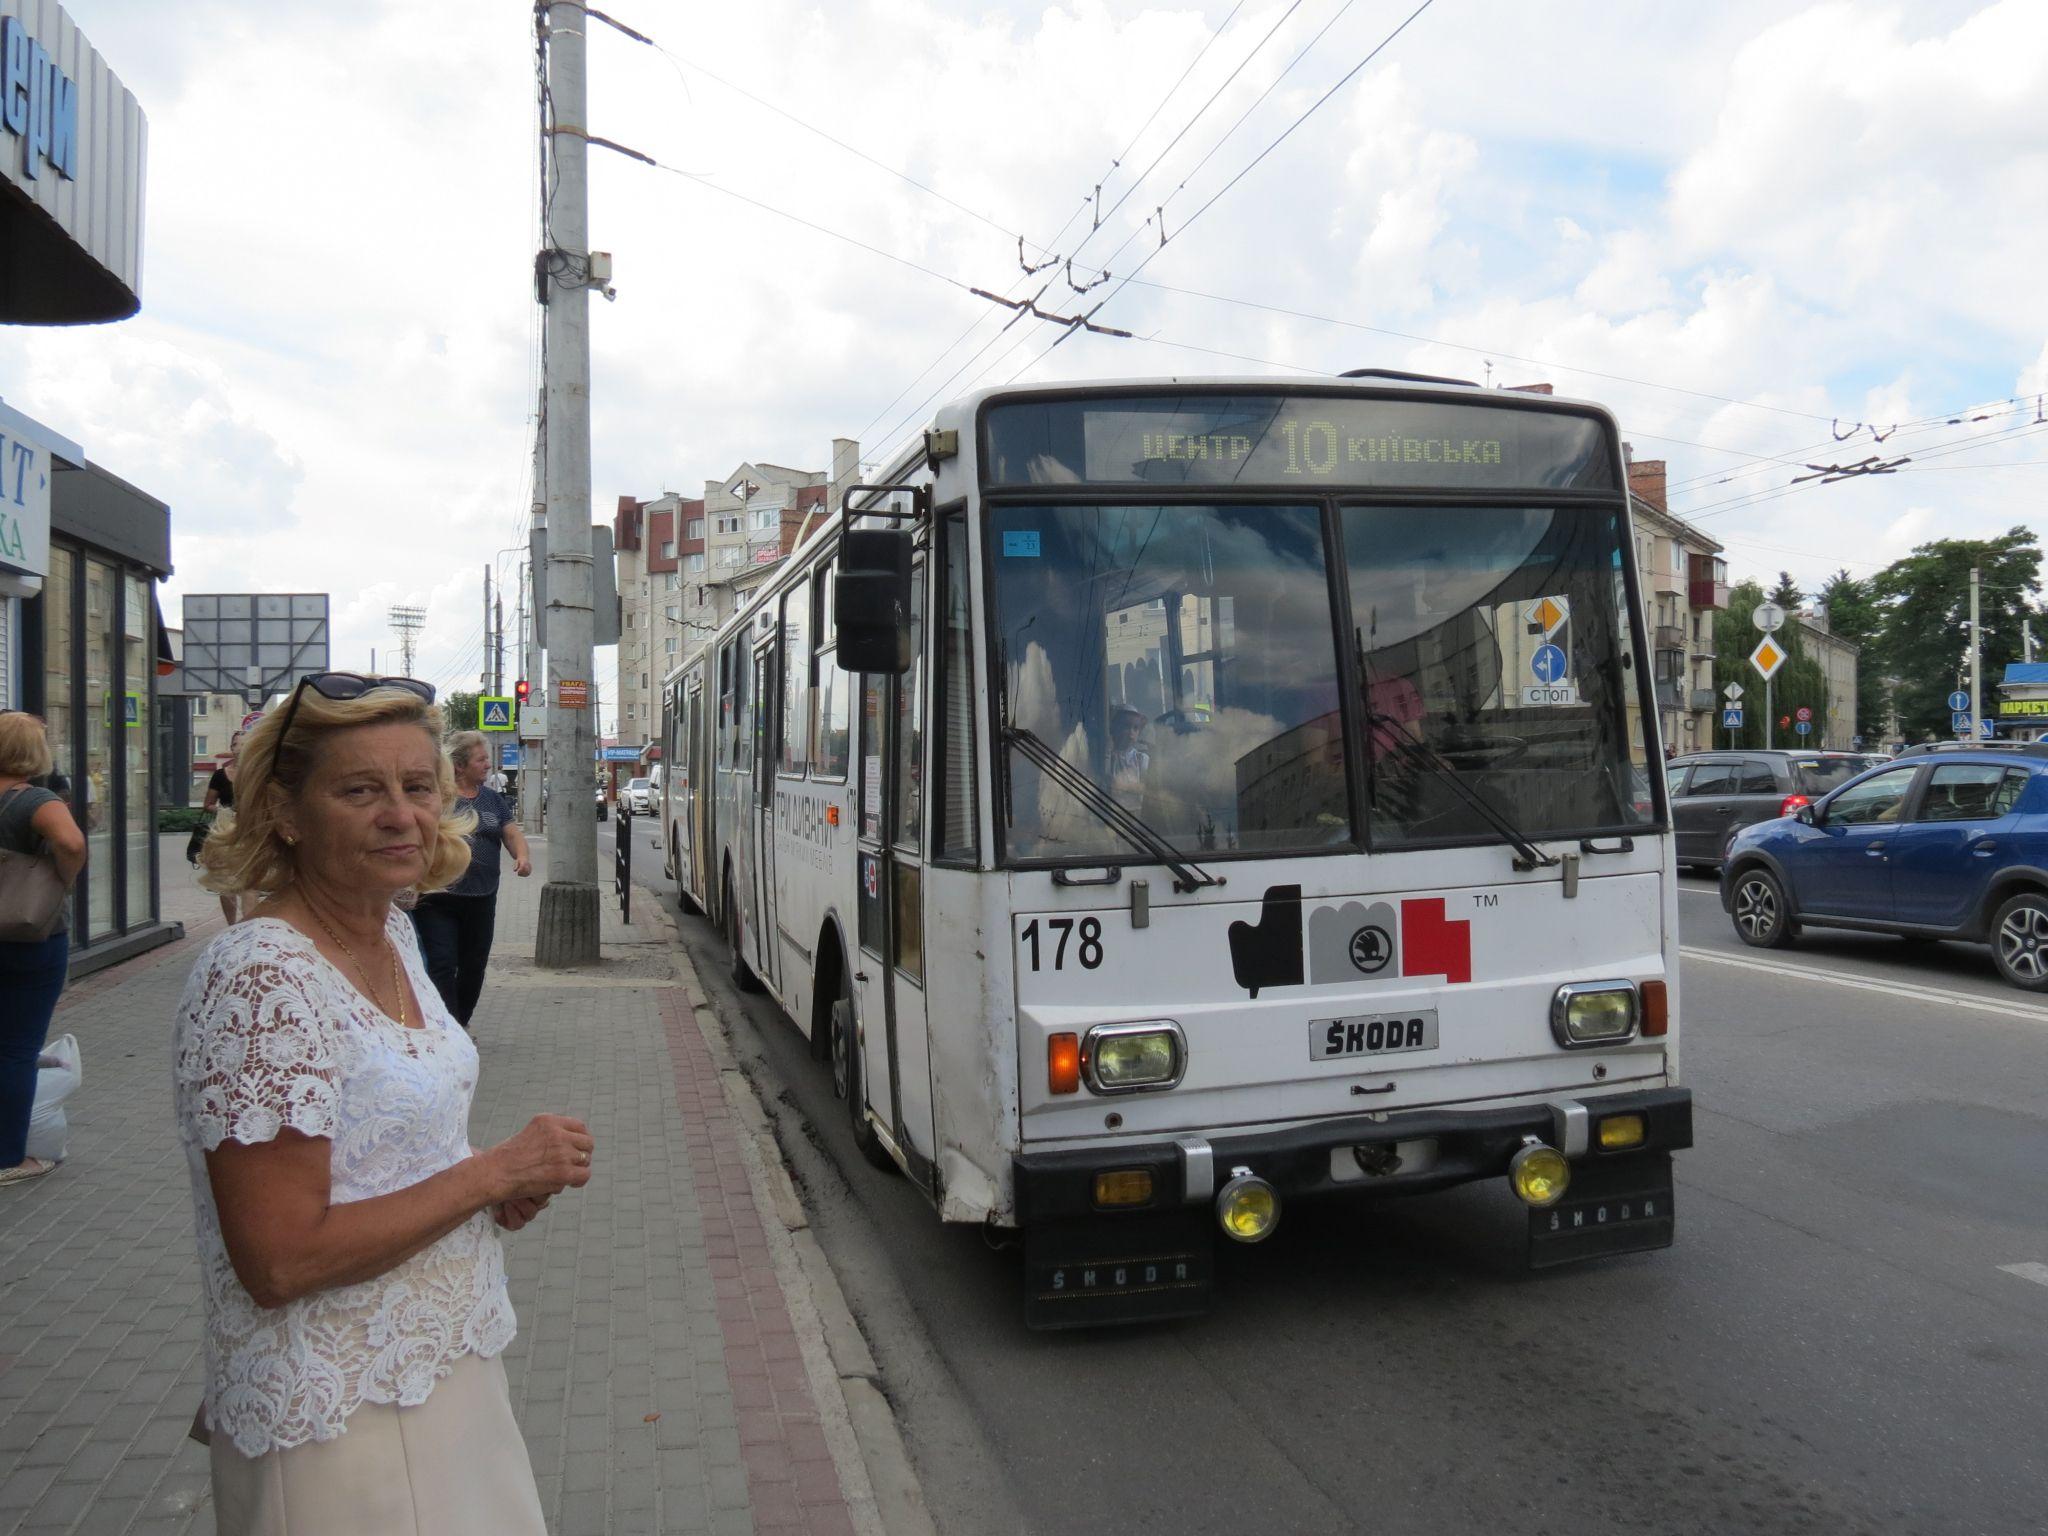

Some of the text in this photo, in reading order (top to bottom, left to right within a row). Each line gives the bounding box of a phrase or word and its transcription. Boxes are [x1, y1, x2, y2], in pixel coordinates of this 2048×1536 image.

[0, 15, 78, 182] ери
[1143, 420, 1502, 475] ЦЕНТР 10 КИЇВСЬКА
[1530, 690, 1569, 702] СТОП
[776, 791, 791, 833] ТРИ
[792, 794, 833, 850] ДИВАНИ
[1473, 893, 1499, 908] TM
[1021, 916, 1104, 972] 178
[1325, 1018, 1425, 1055] ŠKODA
